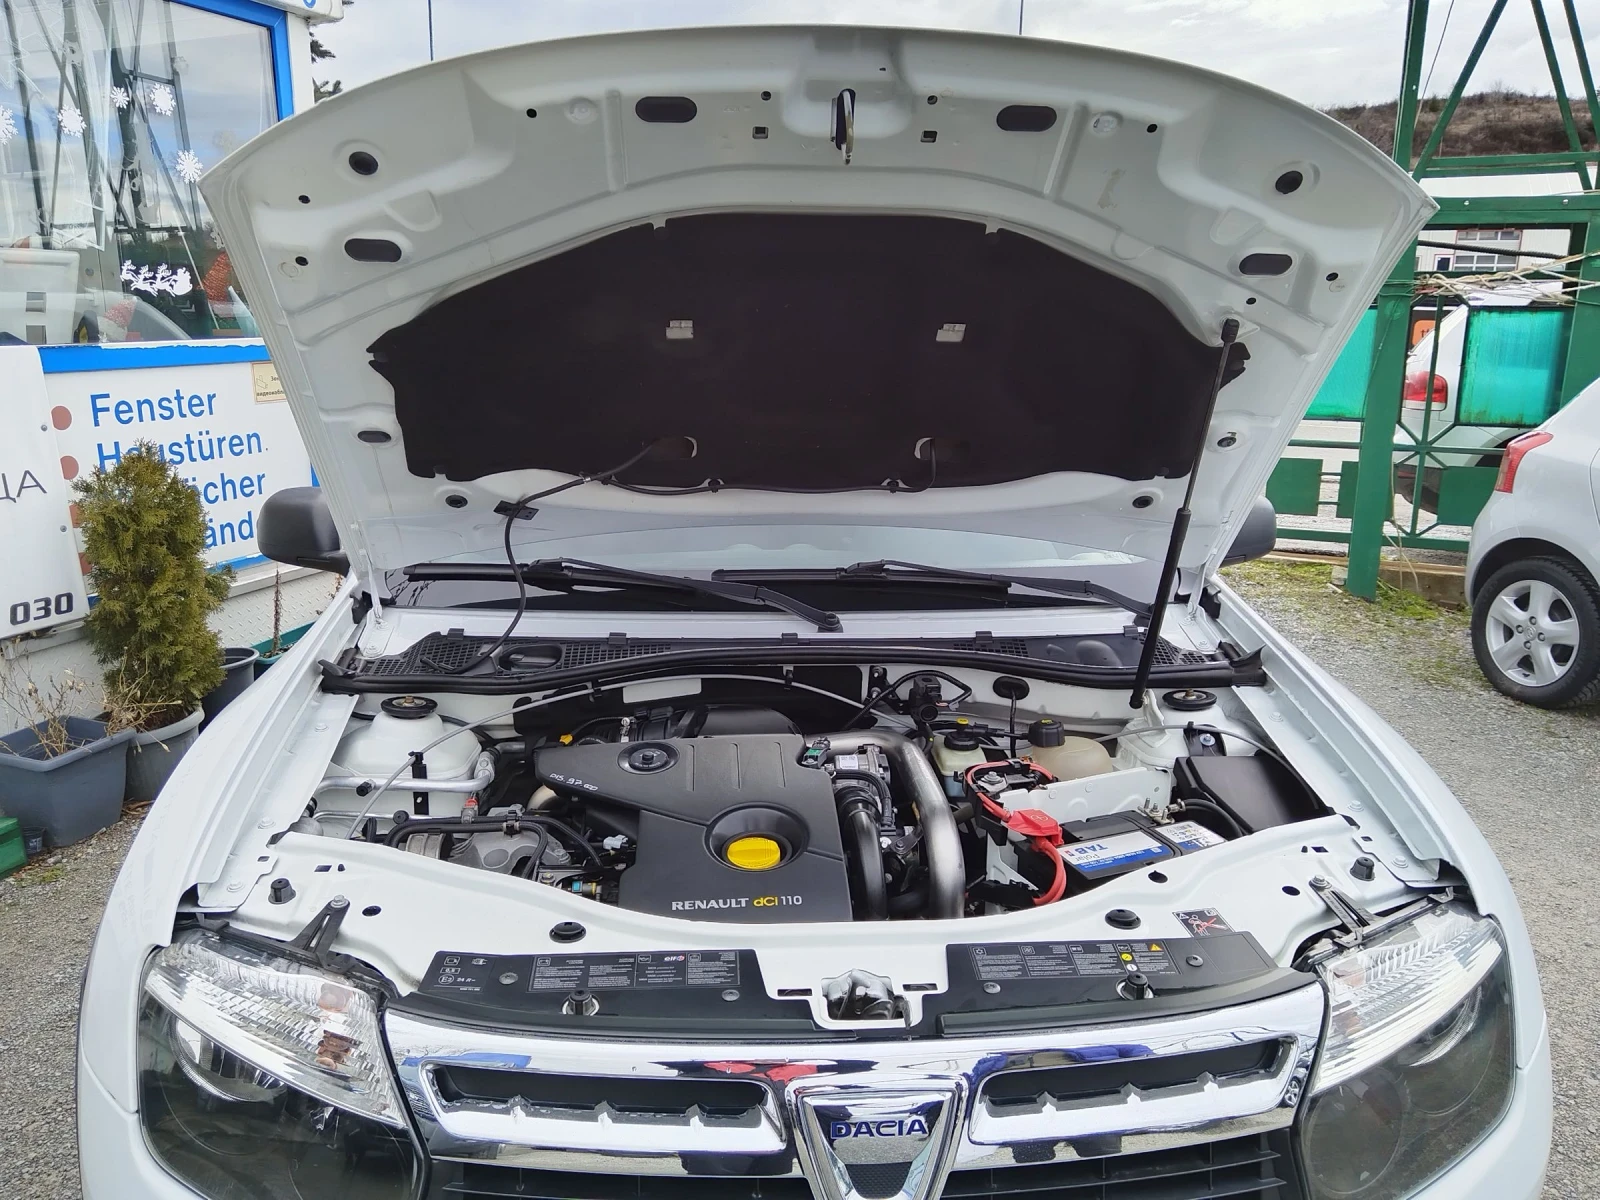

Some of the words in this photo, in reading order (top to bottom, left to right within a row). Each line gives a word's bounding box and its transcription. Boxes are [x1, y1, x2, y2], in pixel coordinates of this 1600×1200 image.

[90, 389, 216, 427] Fenster
[10, 592, 73, 626] 030
[1074, 843, 1109, 855] TAB
[671, 898, 749, 910] RENAULT
[780, 895, 803, 906] 110
[831, 1118, 928, 1138] DACIA
